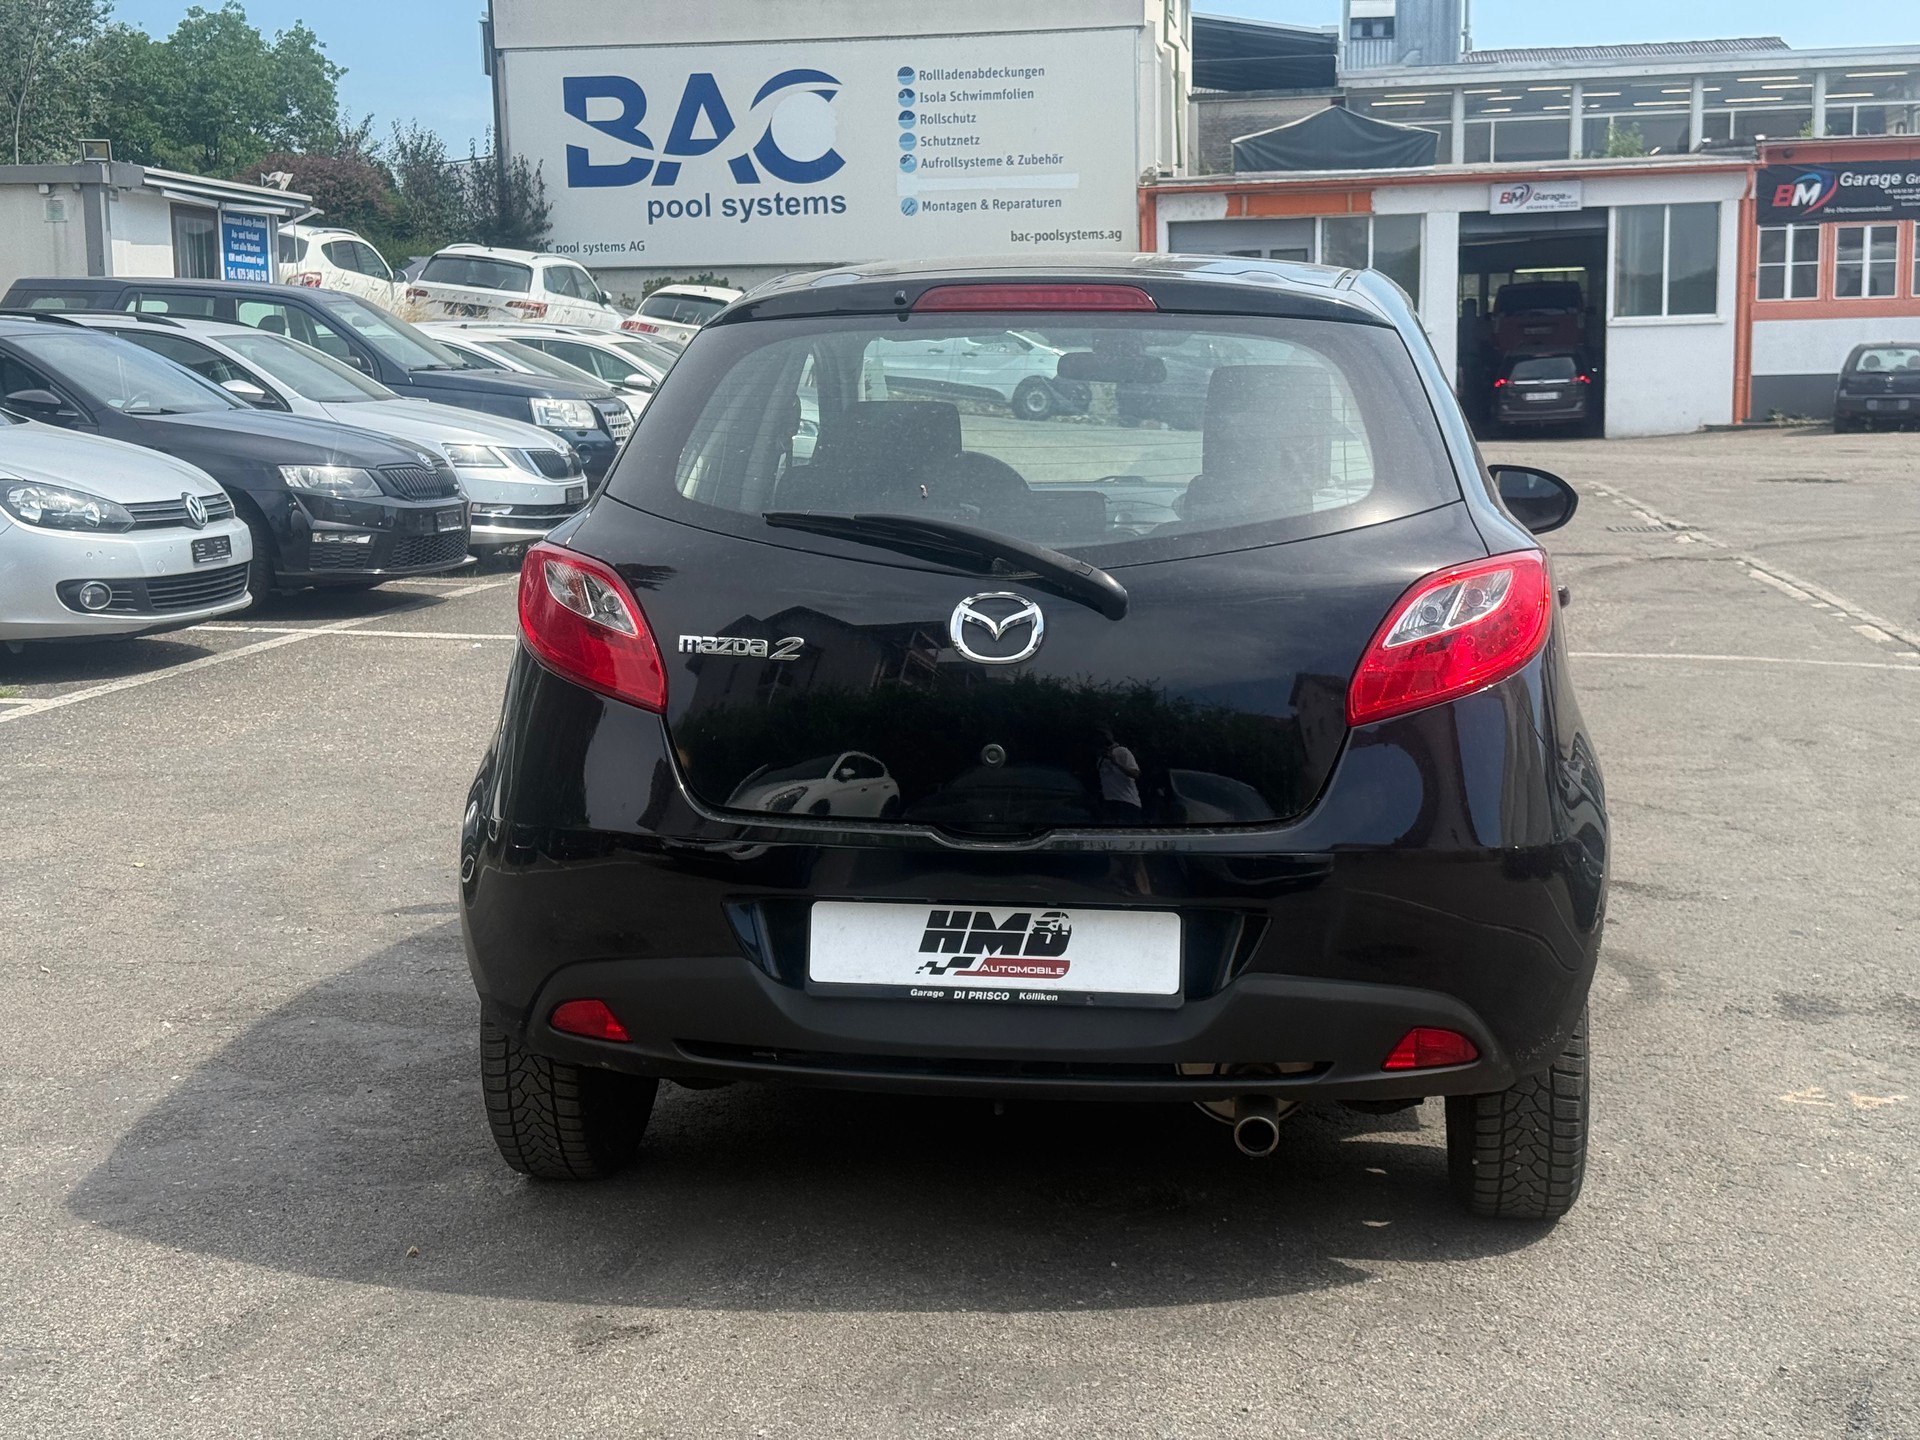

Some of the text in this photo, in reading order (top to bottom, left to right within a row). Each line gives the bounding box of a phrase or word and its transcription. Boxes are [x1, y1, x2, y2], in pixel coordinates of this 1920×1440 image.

[919, 66, 1045, 82] Rollladenabdeckungen
[919, 89, 1035, 103] Isola Schwimmfolien
[919, 113, 977, 125] Rollschutz
[563, 69, 846, 188] BAC
[920, 135, 980, 147] Schutznetz
[921, 153, 1064, 170] Aufrollsysteme & Zubehör
[1772, 183, 1822, 206] BM
[1839, 171, 1902, 189] Garage
[922, 198, 1062, 213] Montagen & Reparaturen
[1500, 192, 1524, 204] BM
[1533, 193, 1566, 202] Garage
[648, 192, 848, 225] pool systems
[1010, 228, 1122, 244] bac-poolsystems.ag
[556, 241, 580, 254] pool
[583, 242, 626, 256] systems
[629, 240, 646, 252] AG
[678, 634, 805, 661] mazda 2
[979, 963, 1066, 976] AUTOMOBILE
[910, 987, 1059, 1002] Garage DI PRISCO Kölliken
